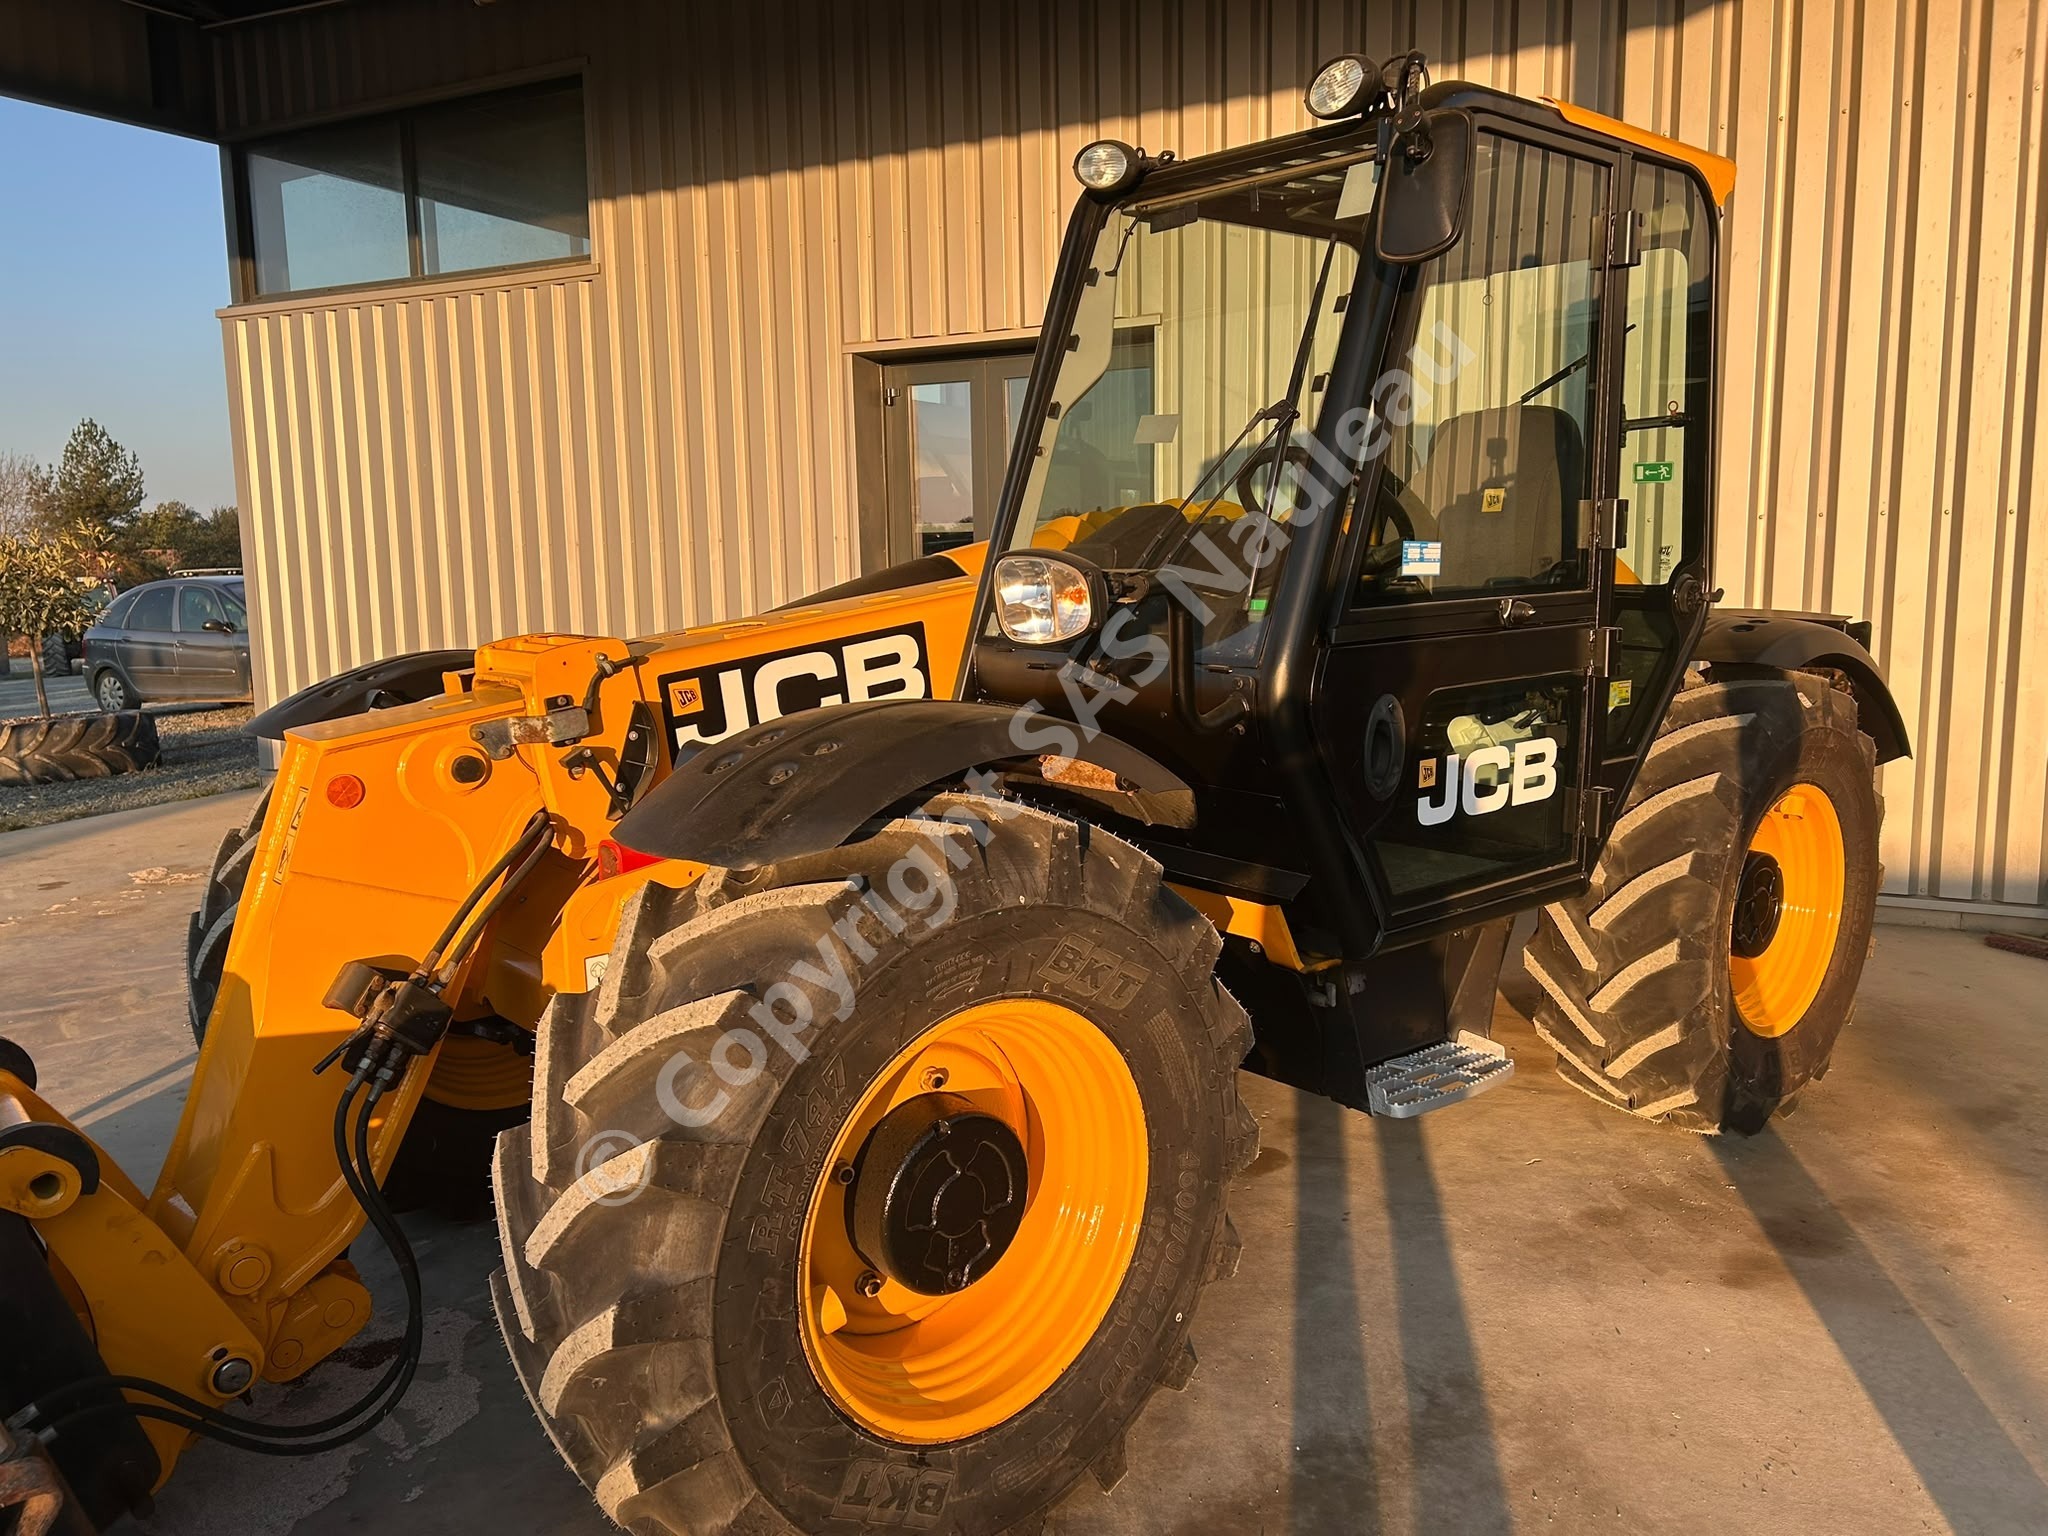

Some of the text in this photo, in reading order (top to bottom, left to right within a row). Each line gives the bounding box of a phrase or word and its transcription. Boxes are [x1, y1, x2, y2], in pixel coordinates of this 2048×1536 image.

[675, 634, 926, 749] JCB
[677, 690, 697, 706] JCB
[1417, 737, 1558, 826] JCB
[1045, 938, 1146, 1004] BKT
[781, 1052, 847, 1160] 747
[838, 1465, 952, 1521] BKT
